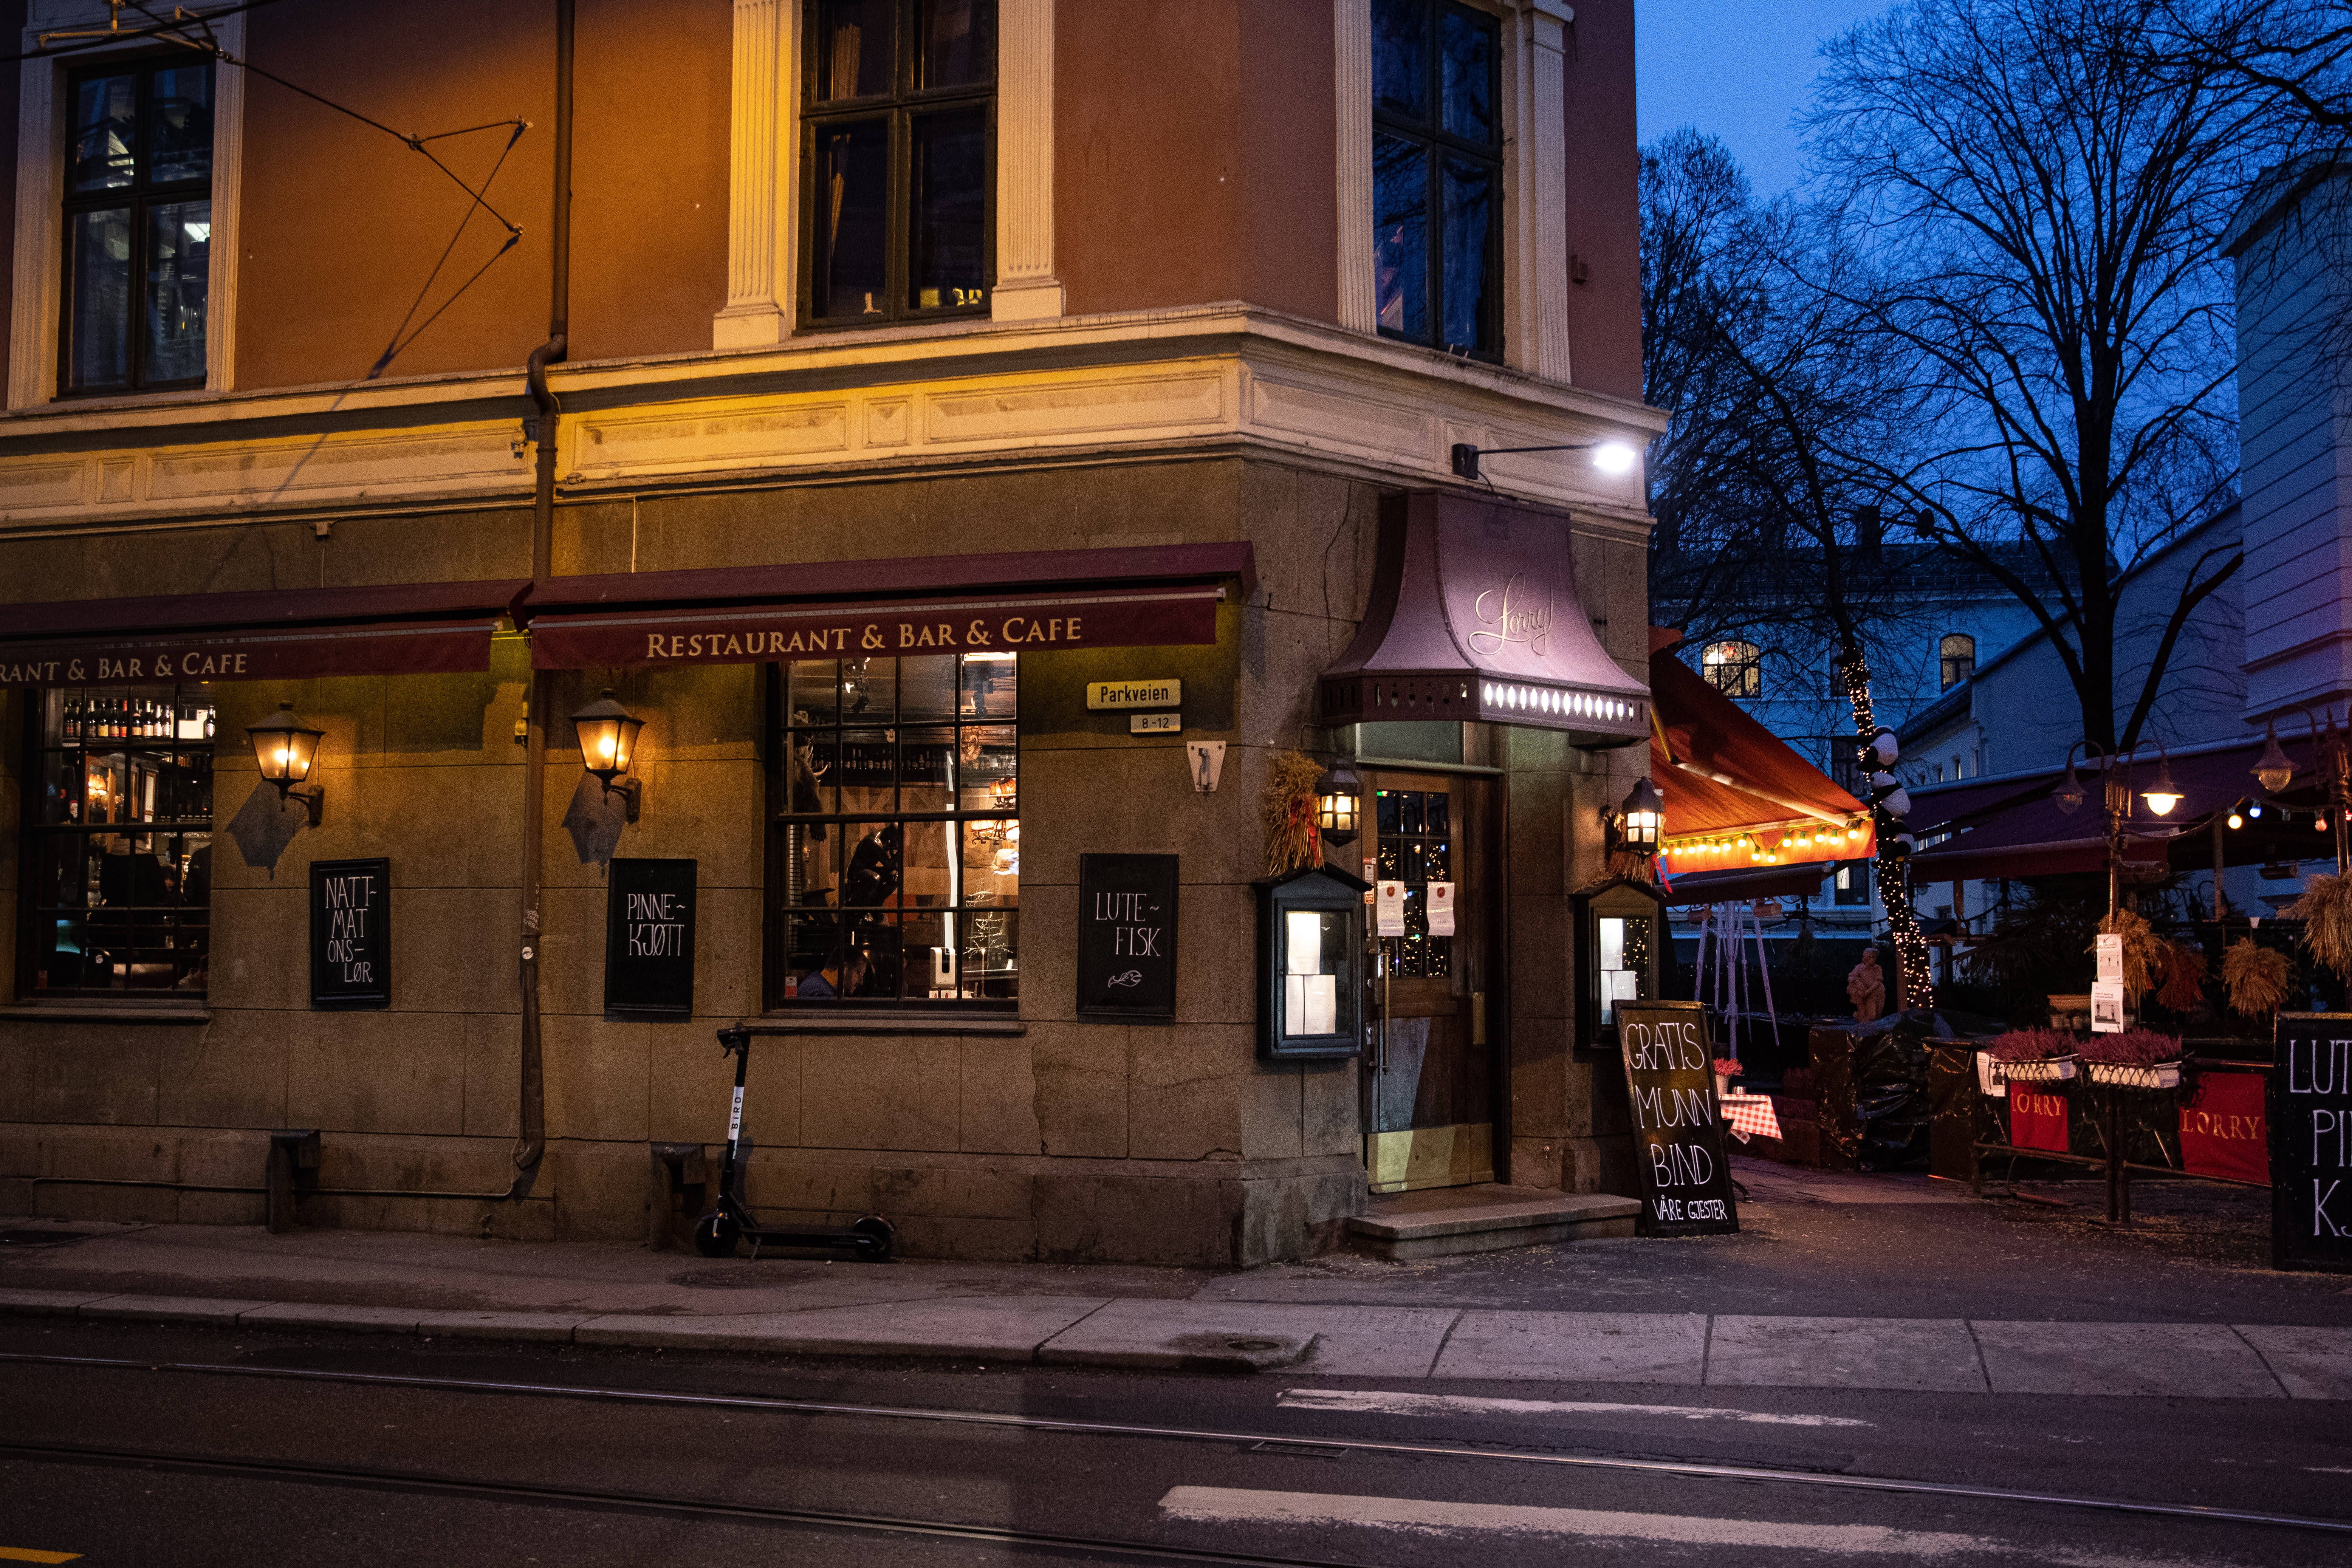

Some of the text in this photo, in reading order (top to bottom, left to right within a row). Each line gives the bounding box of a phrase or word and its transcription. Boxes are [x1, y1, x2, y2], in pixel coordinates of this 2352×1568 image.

[647, 617, 1082, 658] RESTAURANT & BAR & CAFE
[67, 659, 86, 680] &
[98, 658, 144, 679] BAR
[155, 654, 173, 677] &
[182, 652, 248, 675] CAFE
[1101, 684, 1169, 703] Parkveien
[330, 909, 368, 939] MAT
[629, 924, 685, 957] KJØTT
[1115, 927, 1161, 957] FISK
[344, 961, 373, 983] LØR
[1626, 1022, 1705, 1070] GRATIS
[1635, 1085, 1712, 1129] MUNN
[2011, 1092, 2064, 1117] LORRY
[2182, 1110, 2261, 1139] LORRY
[1651, 1143, 1713, 1187] BIND
[1652, 1195, 1728, 1221] VÅRE GJESTER
